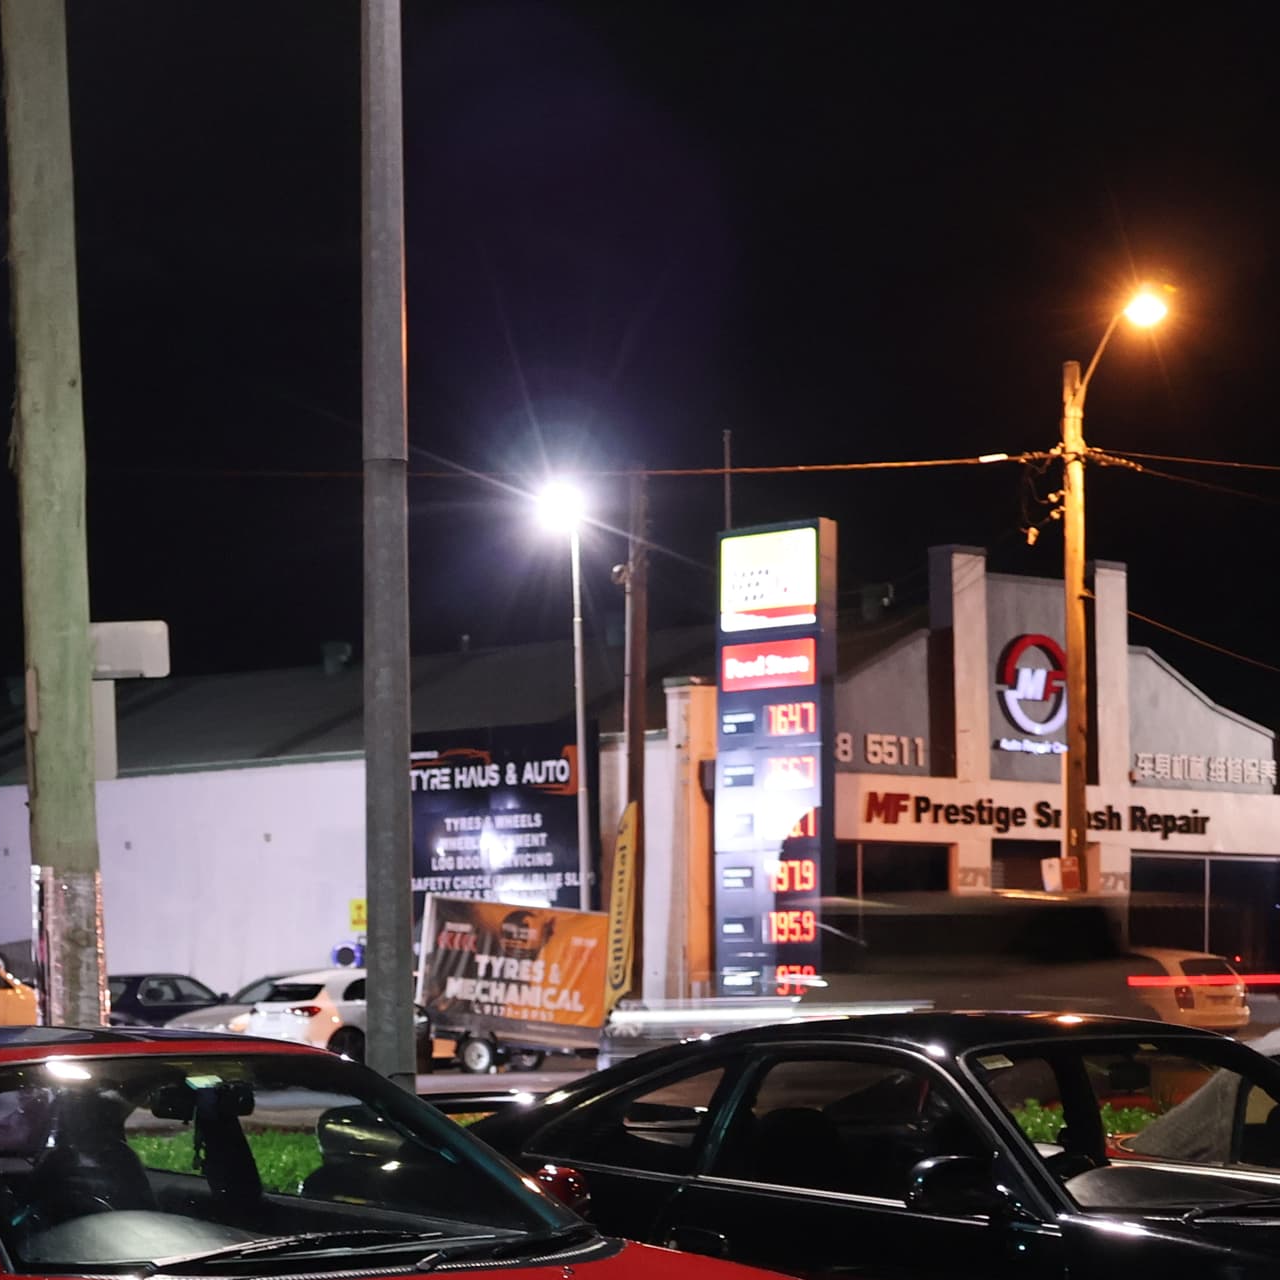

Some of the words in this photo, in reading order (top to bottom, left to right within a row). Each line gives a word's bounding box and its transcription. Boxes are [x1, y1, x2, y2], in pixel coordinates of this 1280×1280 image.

[866, 734, 924, 766] 5511
[410, 767, 452, 791] TYRE
[454, 763, 500, 790] HAUS
[505, 762, 518, 786] &
[522, 758, 570, 784] AUTO
[864, 792, 910, 824] MF
[913, 796, 1027, 833] Prestige
[1035, 800, 1123, 832] Ssh
[1128, 804, 1211, 839] Repair
[474, 954, 545, 983] TYRES
[445, 977, 585, 1012] MECHANICAL
